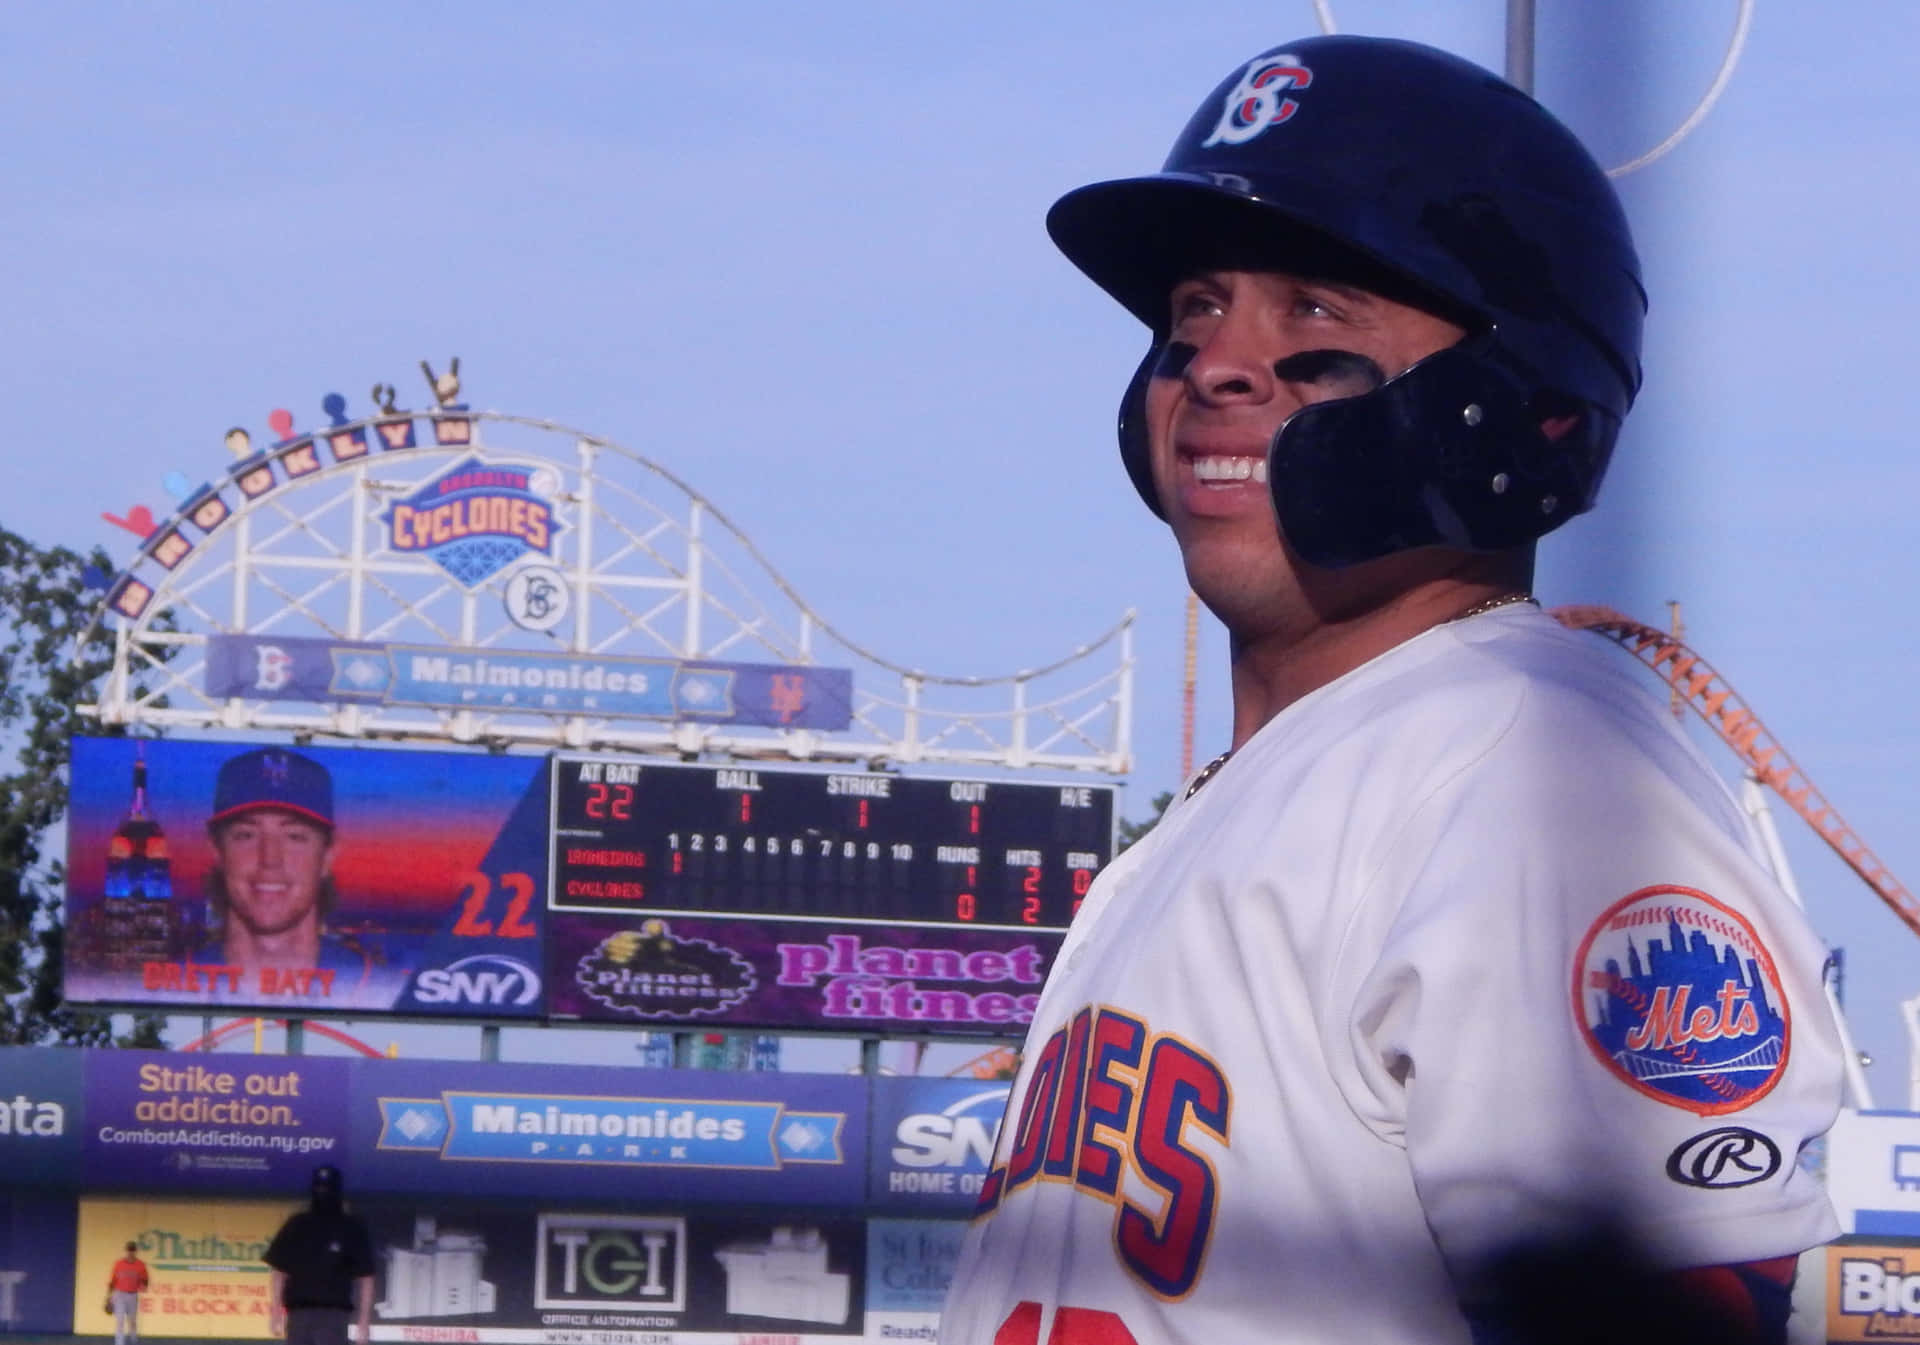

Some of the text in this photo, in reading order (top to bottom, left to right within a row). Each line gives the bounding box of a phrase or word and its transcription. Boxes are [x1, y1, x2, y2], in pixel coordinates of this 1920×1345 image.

[113, 417, 471, 618] BROOKLYN
[393, 497, 550, 549] CYCLONES
[411, 655, 648, 695] Maimonides
[579, 763, 641, 784] AT BAT
[716, 769, 762, 791] BALL
[827, 775, 891, 798] STRIKE
[585, 783, 634, 820] 22
[951, 782, 986, 802] OUT
[742, 793, 751, 822] 1
[859, 799, 869, 828] 1
[970, 805, 980, 833] 1
[668, 833, 912, 860] 1 2 3 4 5 6 7 8 9 10
[937, 846, 980, 864] RUNS
[1006, 850, 1042, 867] HITS
[672, 852, 683, 874] 1
[567, 880, 645, 899] CYCLONES
[967, 866, 1091, 895] 1 2 0
[453, 872, 537, 938] 22
[957, 893, 976, 921] 0
[1023, 897, 1041, 923] 2
[777, 935, 1043, 986] planet
[142, 962, 336, 997] BRETT BATY
[414, 971, 527, 1006] SNY
[598, 968, 712, 985] planet
[613, 981, 737, 998] fitness
[1626, 979, 1760, 1051] Mets
[139, 1063, 300, 1096] Strike out
[135, 1096, 300, 1126] addiction.
[472, 1104, 745, 1141] Maimonides
[99, 1126, 335, 1153] CombatAddiction.ny.gov
[889, 1171, 955, 1193] HOME
[554, 1231, 666, 1295] TGI
[181, 1285, 229, 1297] AFTER
[162, 1299, 240, 1315] BLOCK
[541, 1314, 588, 1326] OFFICE
[402, 1327, 478, 1342] TOSHIBA
